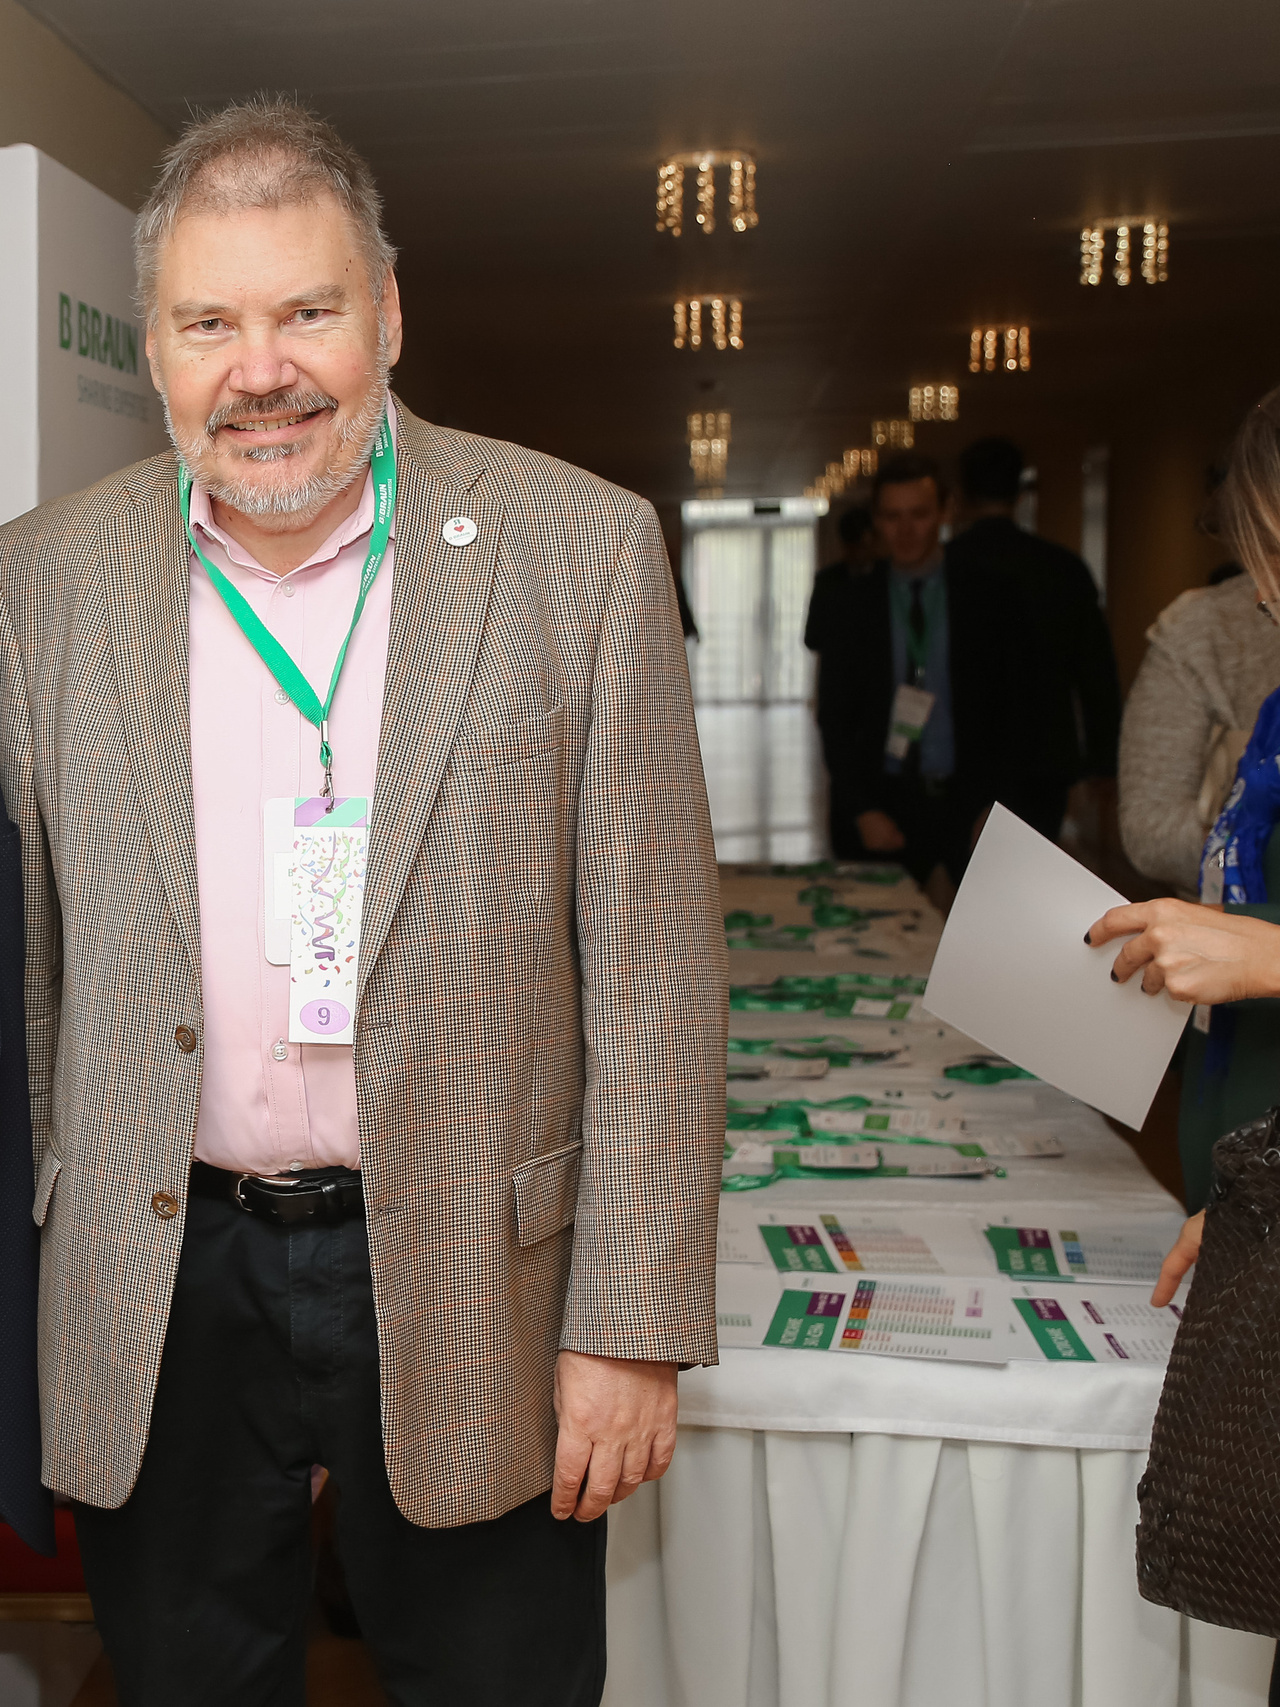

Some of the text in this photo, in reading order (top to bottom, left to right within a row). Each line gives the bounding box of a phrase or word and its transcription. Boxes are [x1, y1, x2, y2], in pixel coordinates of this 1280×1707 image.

[59, 292, 138, 376] B BRAUN
[317, 1006, 330, 1026] 9
